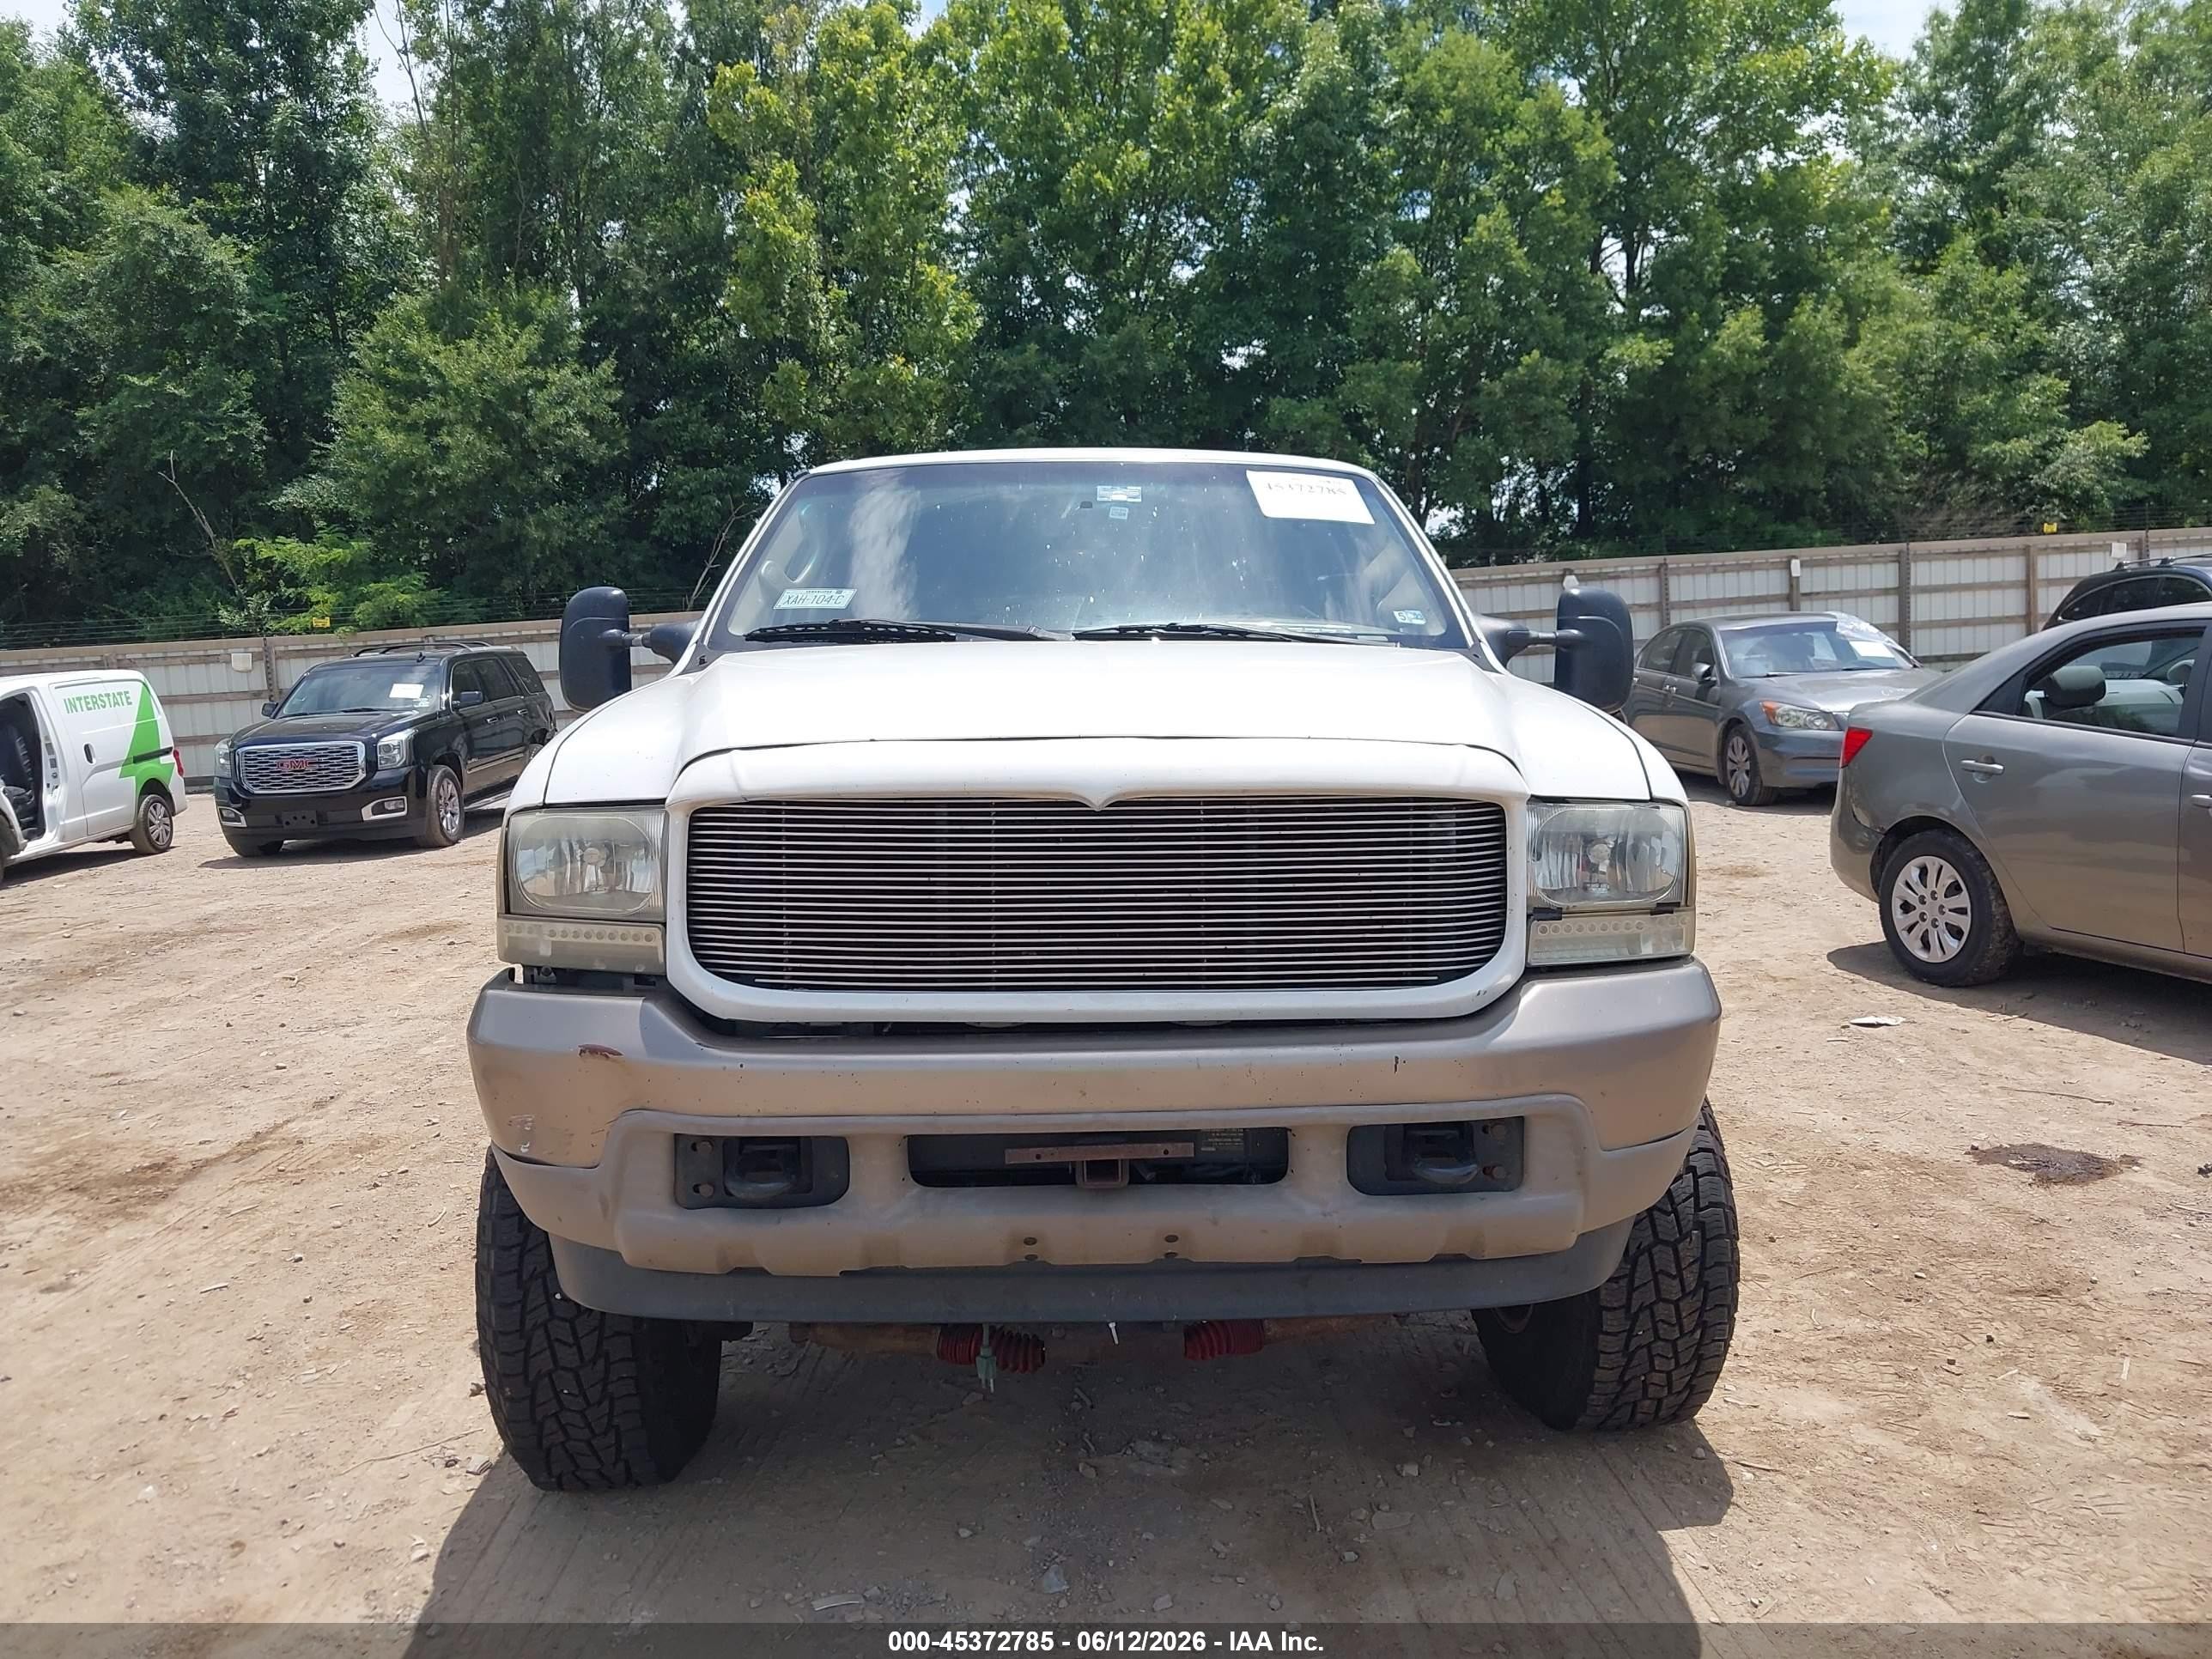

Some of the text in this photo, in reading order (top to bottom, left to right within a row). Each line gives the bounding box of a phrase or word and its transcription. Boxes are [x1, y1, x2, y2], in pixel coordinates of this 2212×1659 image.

[783, 594, 845, 605] XAH-104-C
[63, 690, 133, 714] INTERSTATE
[276, 758, 319, 772] GMC
